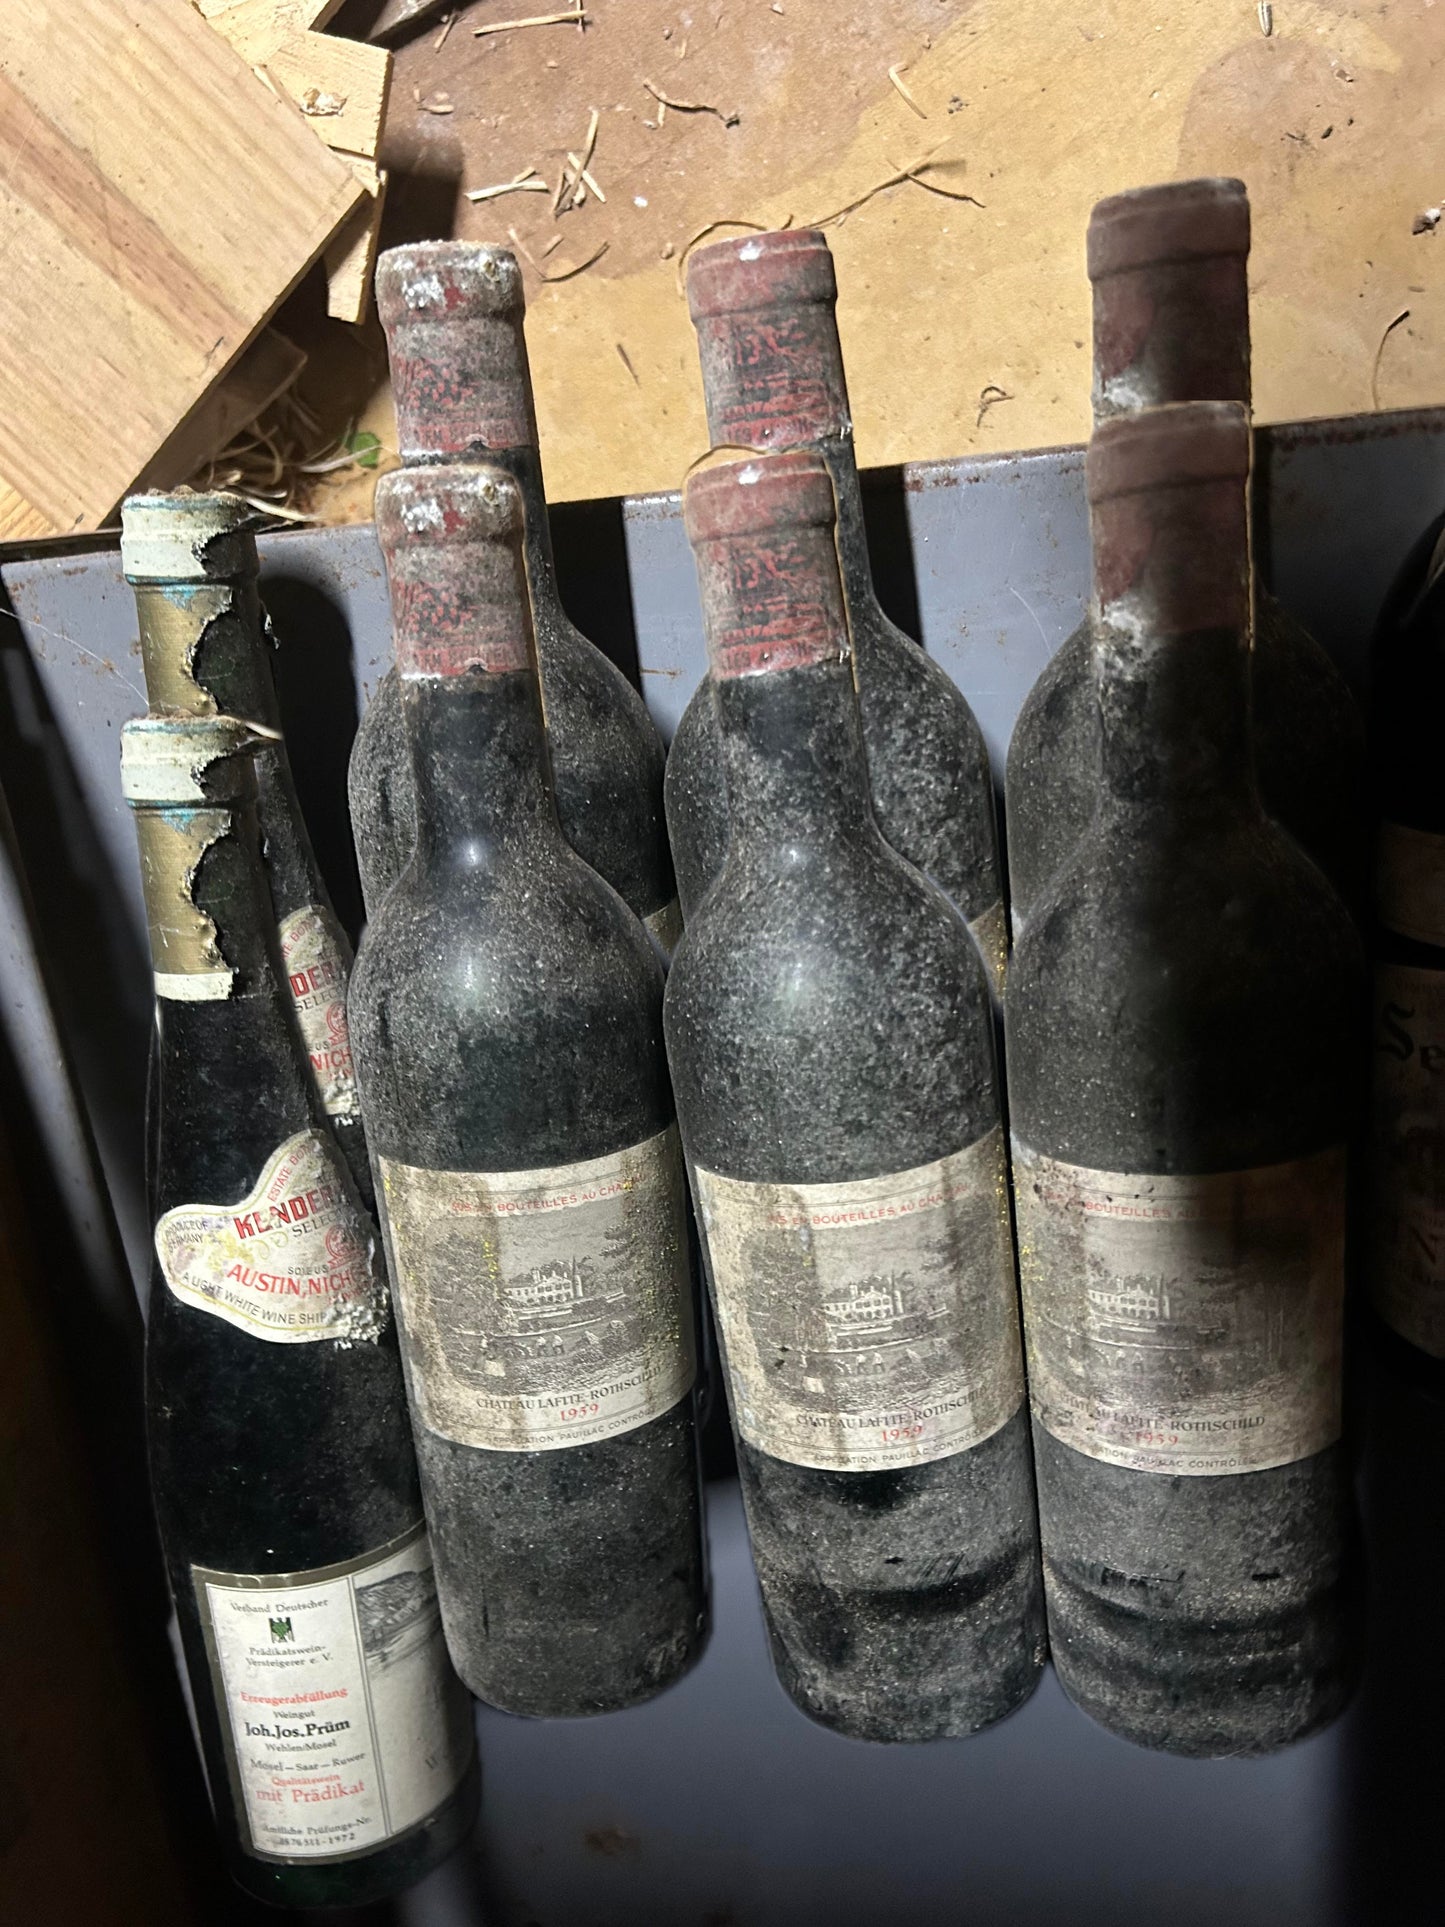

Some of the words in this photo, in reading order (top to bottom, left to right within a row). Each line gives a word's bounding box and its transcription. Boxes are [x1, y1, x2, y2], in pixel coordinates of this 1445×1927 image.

[267, 1167, 292, 1202] ESTATE
[497, 1194, 577, 1212] BOUTEILLES
[582, 1192, 596, 1201] AU
[1086, 1201, 1172, 1219] BOUTEILLES
[812, 1207, 896, 1225] BOUTEILLES
[901, 1203, 915, 1213] AU
[227, 1264, 307, 1299] AUSTIN,
[183, 1272, 190, 1282] A
[192, 1276, 223, 1298] LIGHT
[224, 1289, 261, 1317] WHITE
[262, 1309, 297, 1325] WINE
[560, 1403, 600, 1422] 1959
[560, 1424, 604, 1441] PAUILLAC
[881, 1424, 923, 1442] 1959
[882, 1447, 929, 1462] PAUILLAC
[229, 1602, 271, 1613] Verband
[275, 1599, 329, 1613] Deutscher
[272, 1709, 316, 1720] Weingut
[256, 1789, 283, 1802] mit
[291, 1779, 366, 1803] Prädikat
